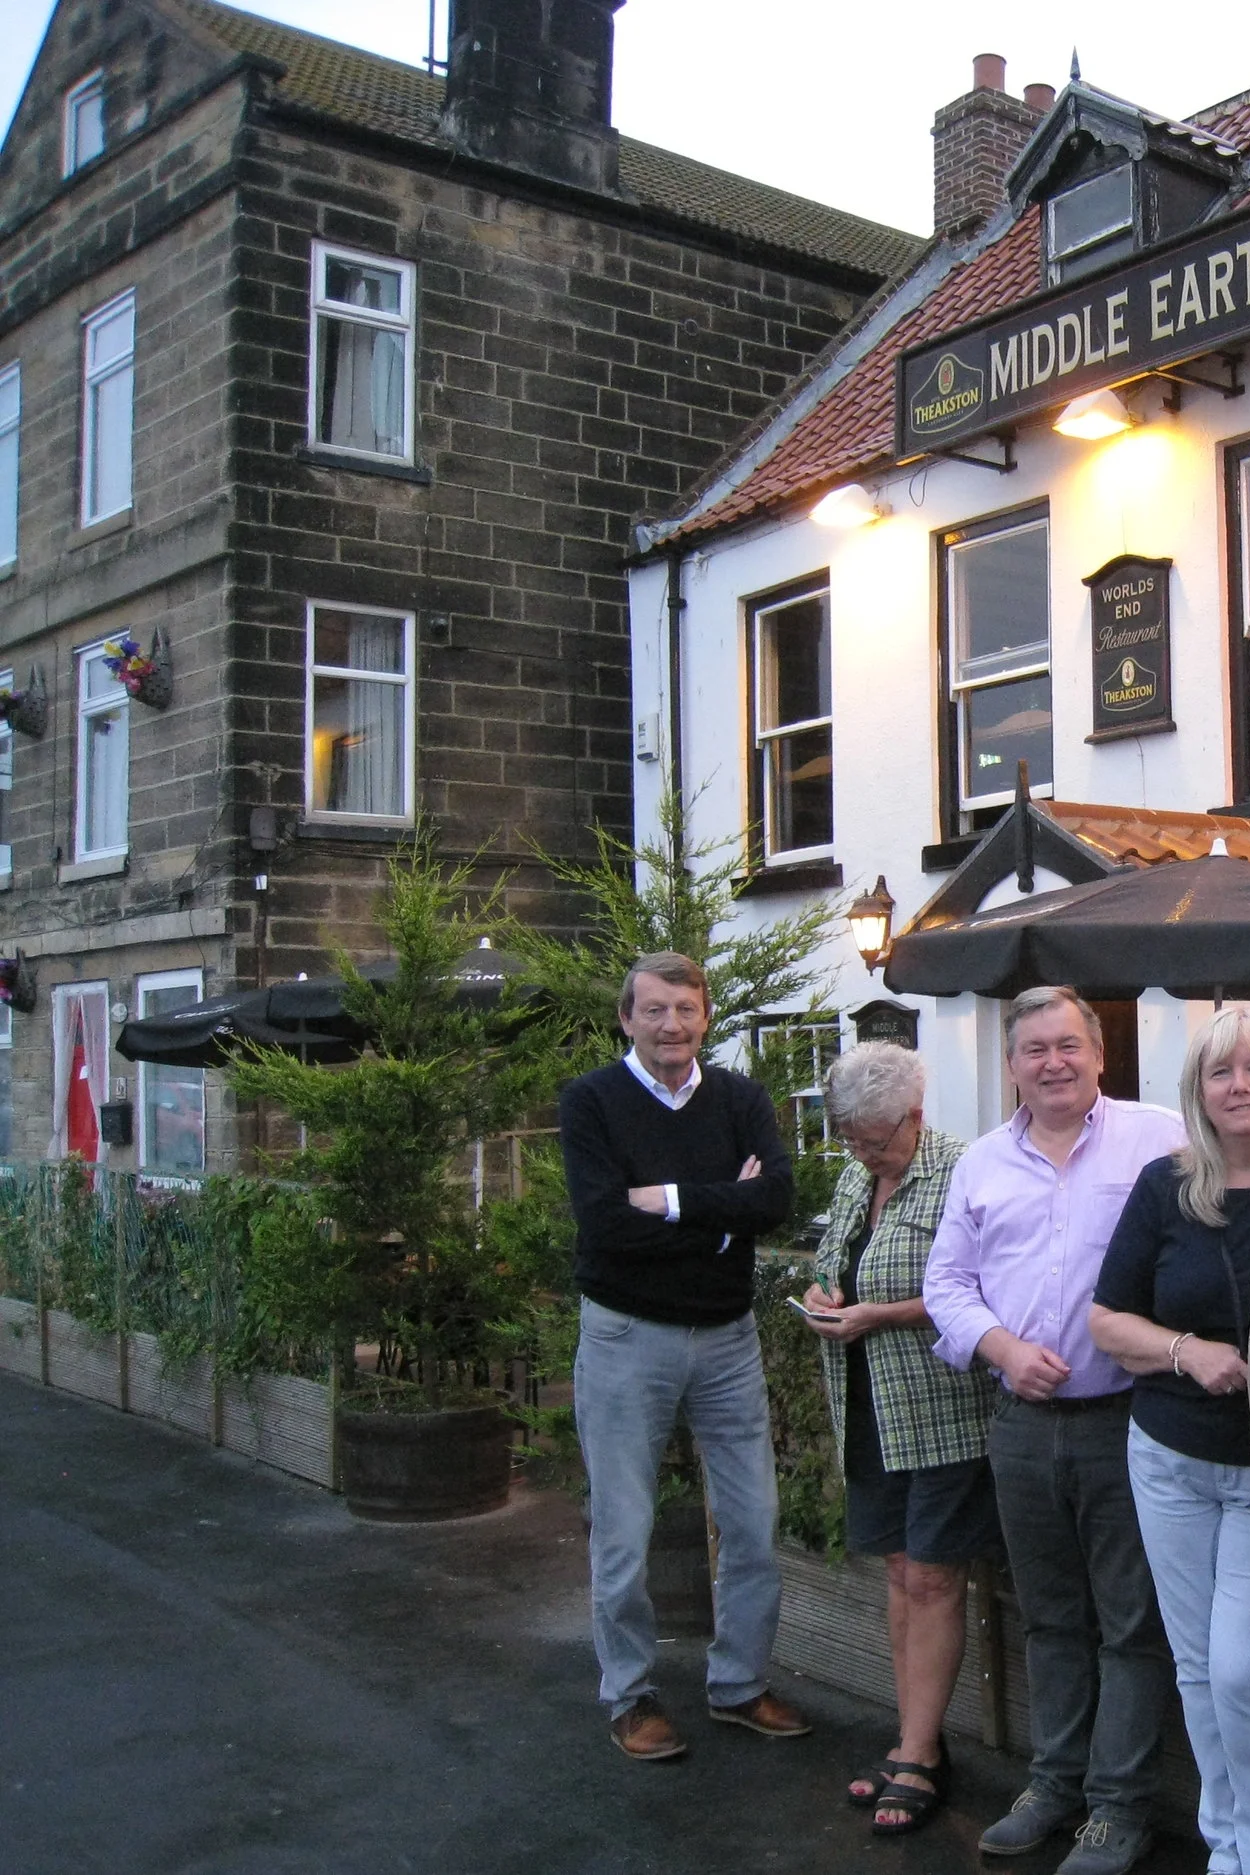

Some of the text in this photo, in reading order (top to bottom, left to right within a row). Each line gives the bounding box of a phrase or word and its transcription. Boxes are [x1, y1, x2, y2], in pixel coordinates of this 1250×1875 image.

[989, 287, 1130, 402] MIDDLE
[914, 387, 979, 425] THEAKSTON
[1101, 577, 1154, 603] WORLDS
[1115, 601, 1141, 620] END
[1095, 620, 1162, 652] Restaurant
[1104, 684, 1153, 704] THEAKSTON
[872, 1022, 898, 1032] MIDDLE
